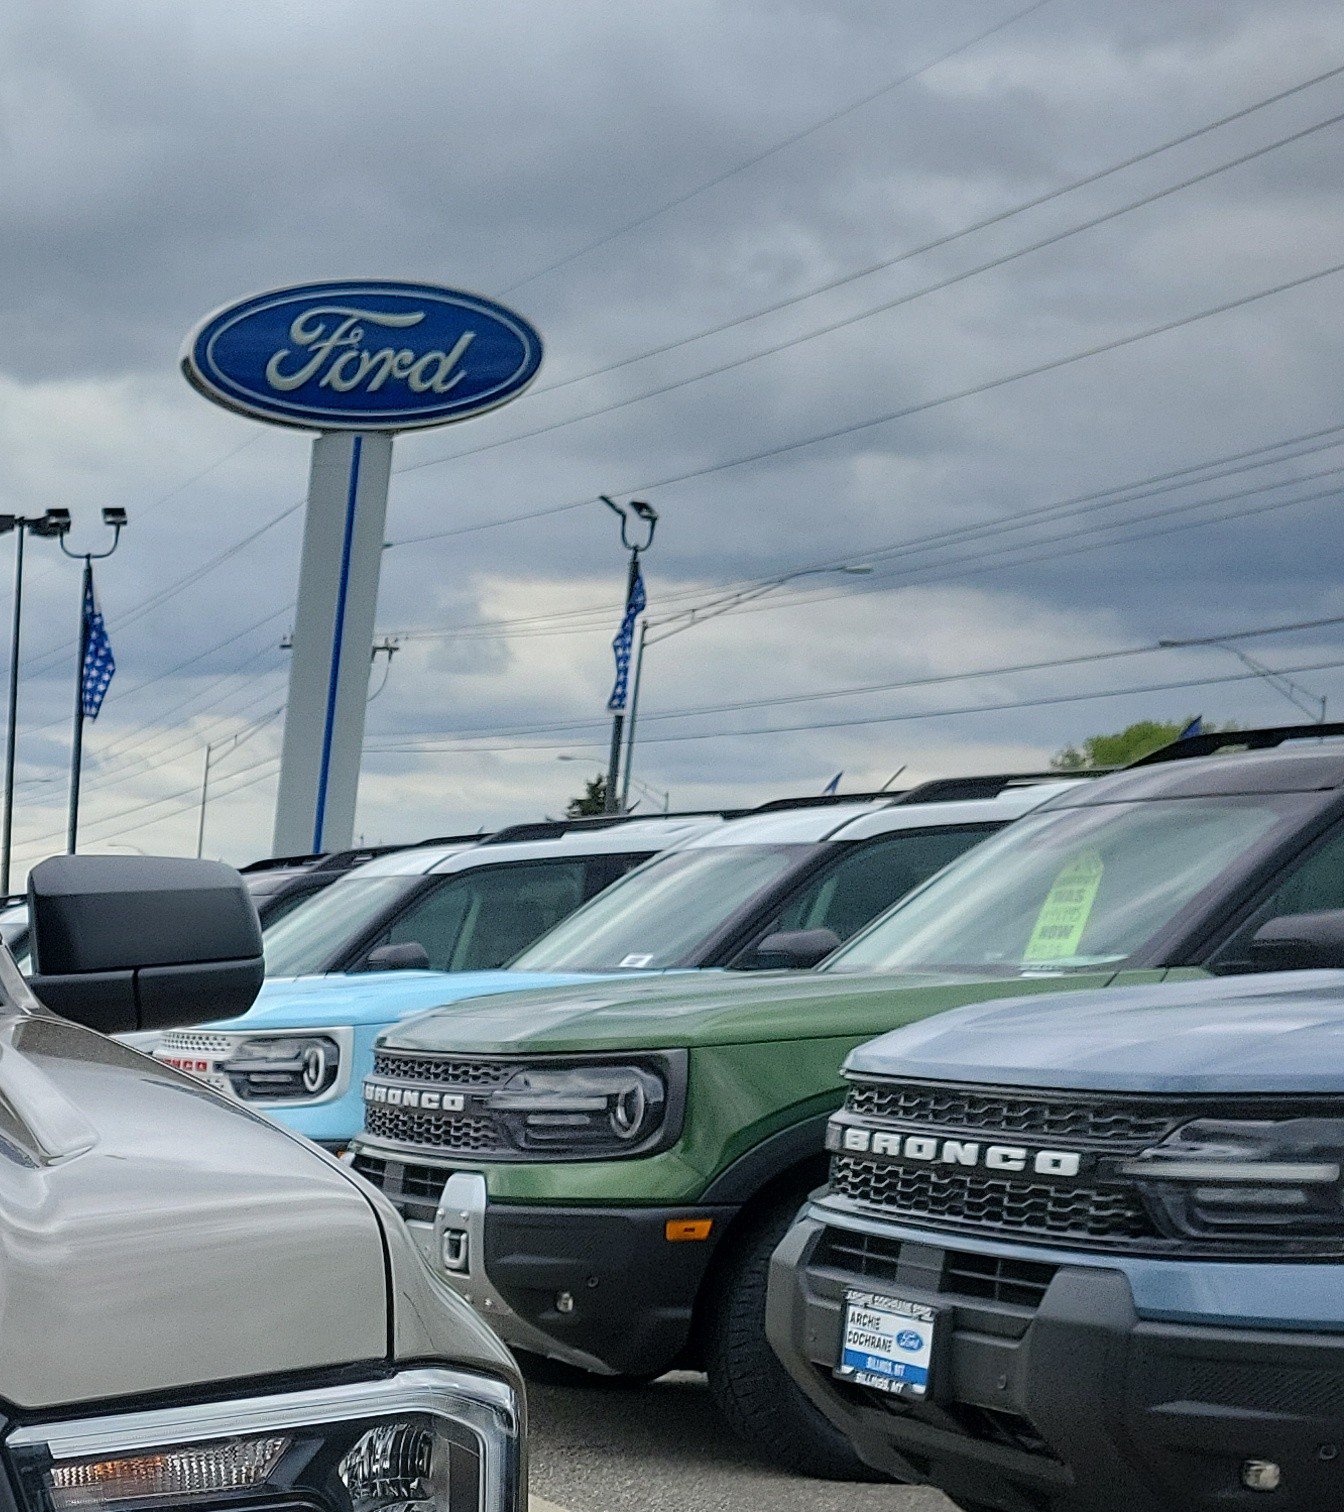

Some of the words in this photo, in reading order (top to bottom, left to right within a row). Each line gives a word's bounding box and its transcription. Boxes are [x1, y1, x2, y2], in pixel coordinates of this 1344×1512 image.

[265, 305, 477, 394] Ford
[364, 1083, 465, 1112] BRONCO
[844, 1127, 1081, 1177] BRONCO
